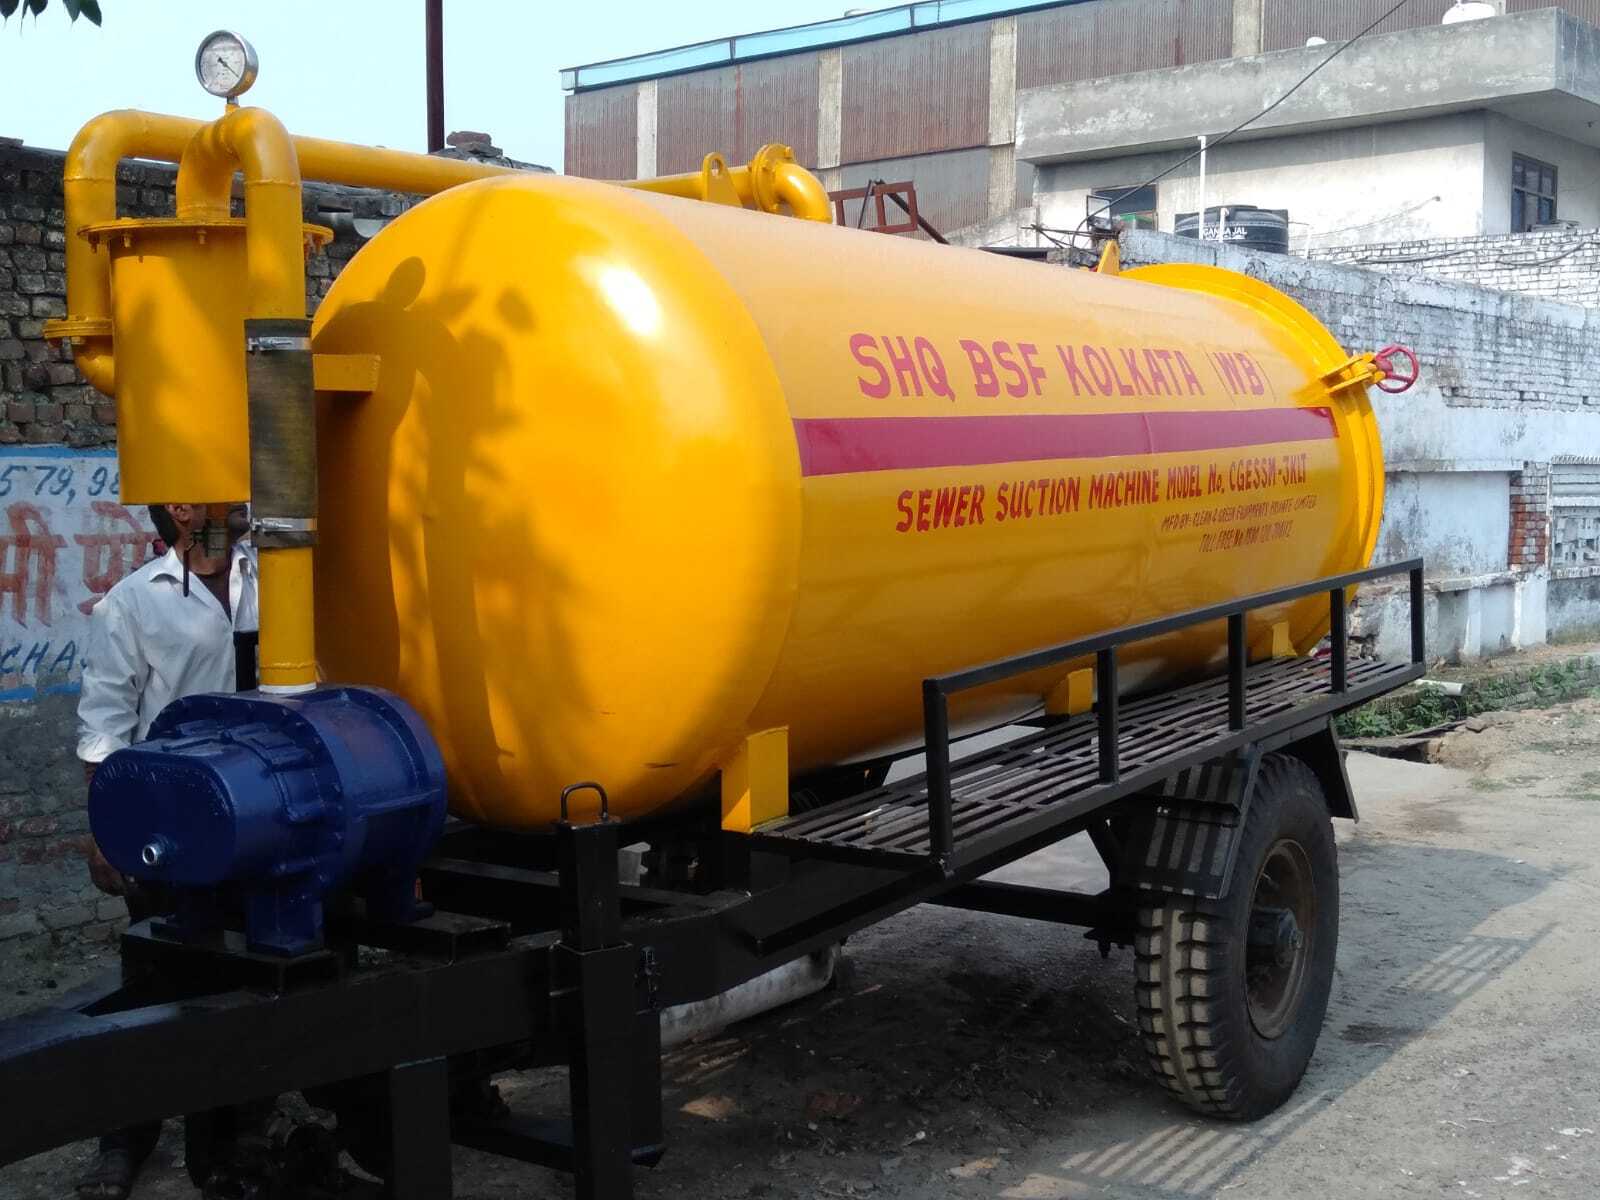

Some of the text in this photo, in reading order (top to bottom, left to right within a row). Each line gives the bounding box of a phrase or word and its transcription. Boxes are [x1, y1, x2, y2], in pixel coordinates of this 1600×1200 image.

[849, 333, 955, 402] SHQ
[959, 340, 1047, 398] BSF
[1055, 345, 1206, 397] KOLKATA
[895, 484, 986, 533] SEWER
[995, 476, 1081, 521] SUCTION
[1087, 468, 1160, 509] MACHINE
[1166, 464, 1202, 501] MODEL
